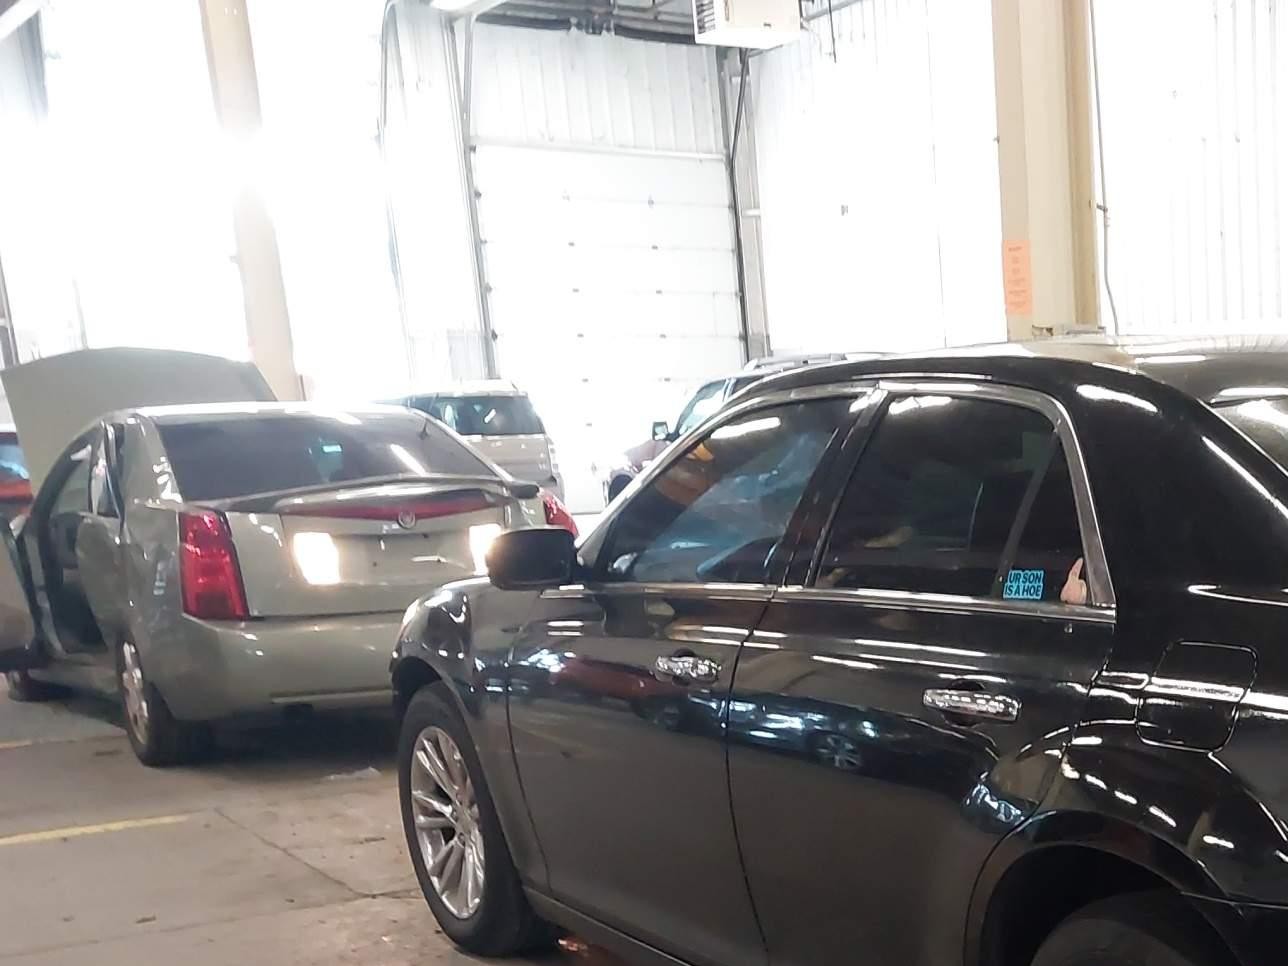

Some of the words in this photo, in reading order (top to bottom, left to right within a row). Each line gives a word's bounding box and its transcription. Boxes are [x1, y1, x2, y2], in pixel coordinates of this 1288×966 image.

[1009, 571, 1021, 584] UR
[1022, 571, 1042, 584] SON
[1004, 584, 1014, 596] IS
[1014, 584, 1021, 596] A
[1022, 584, 1042, 596] HOE
